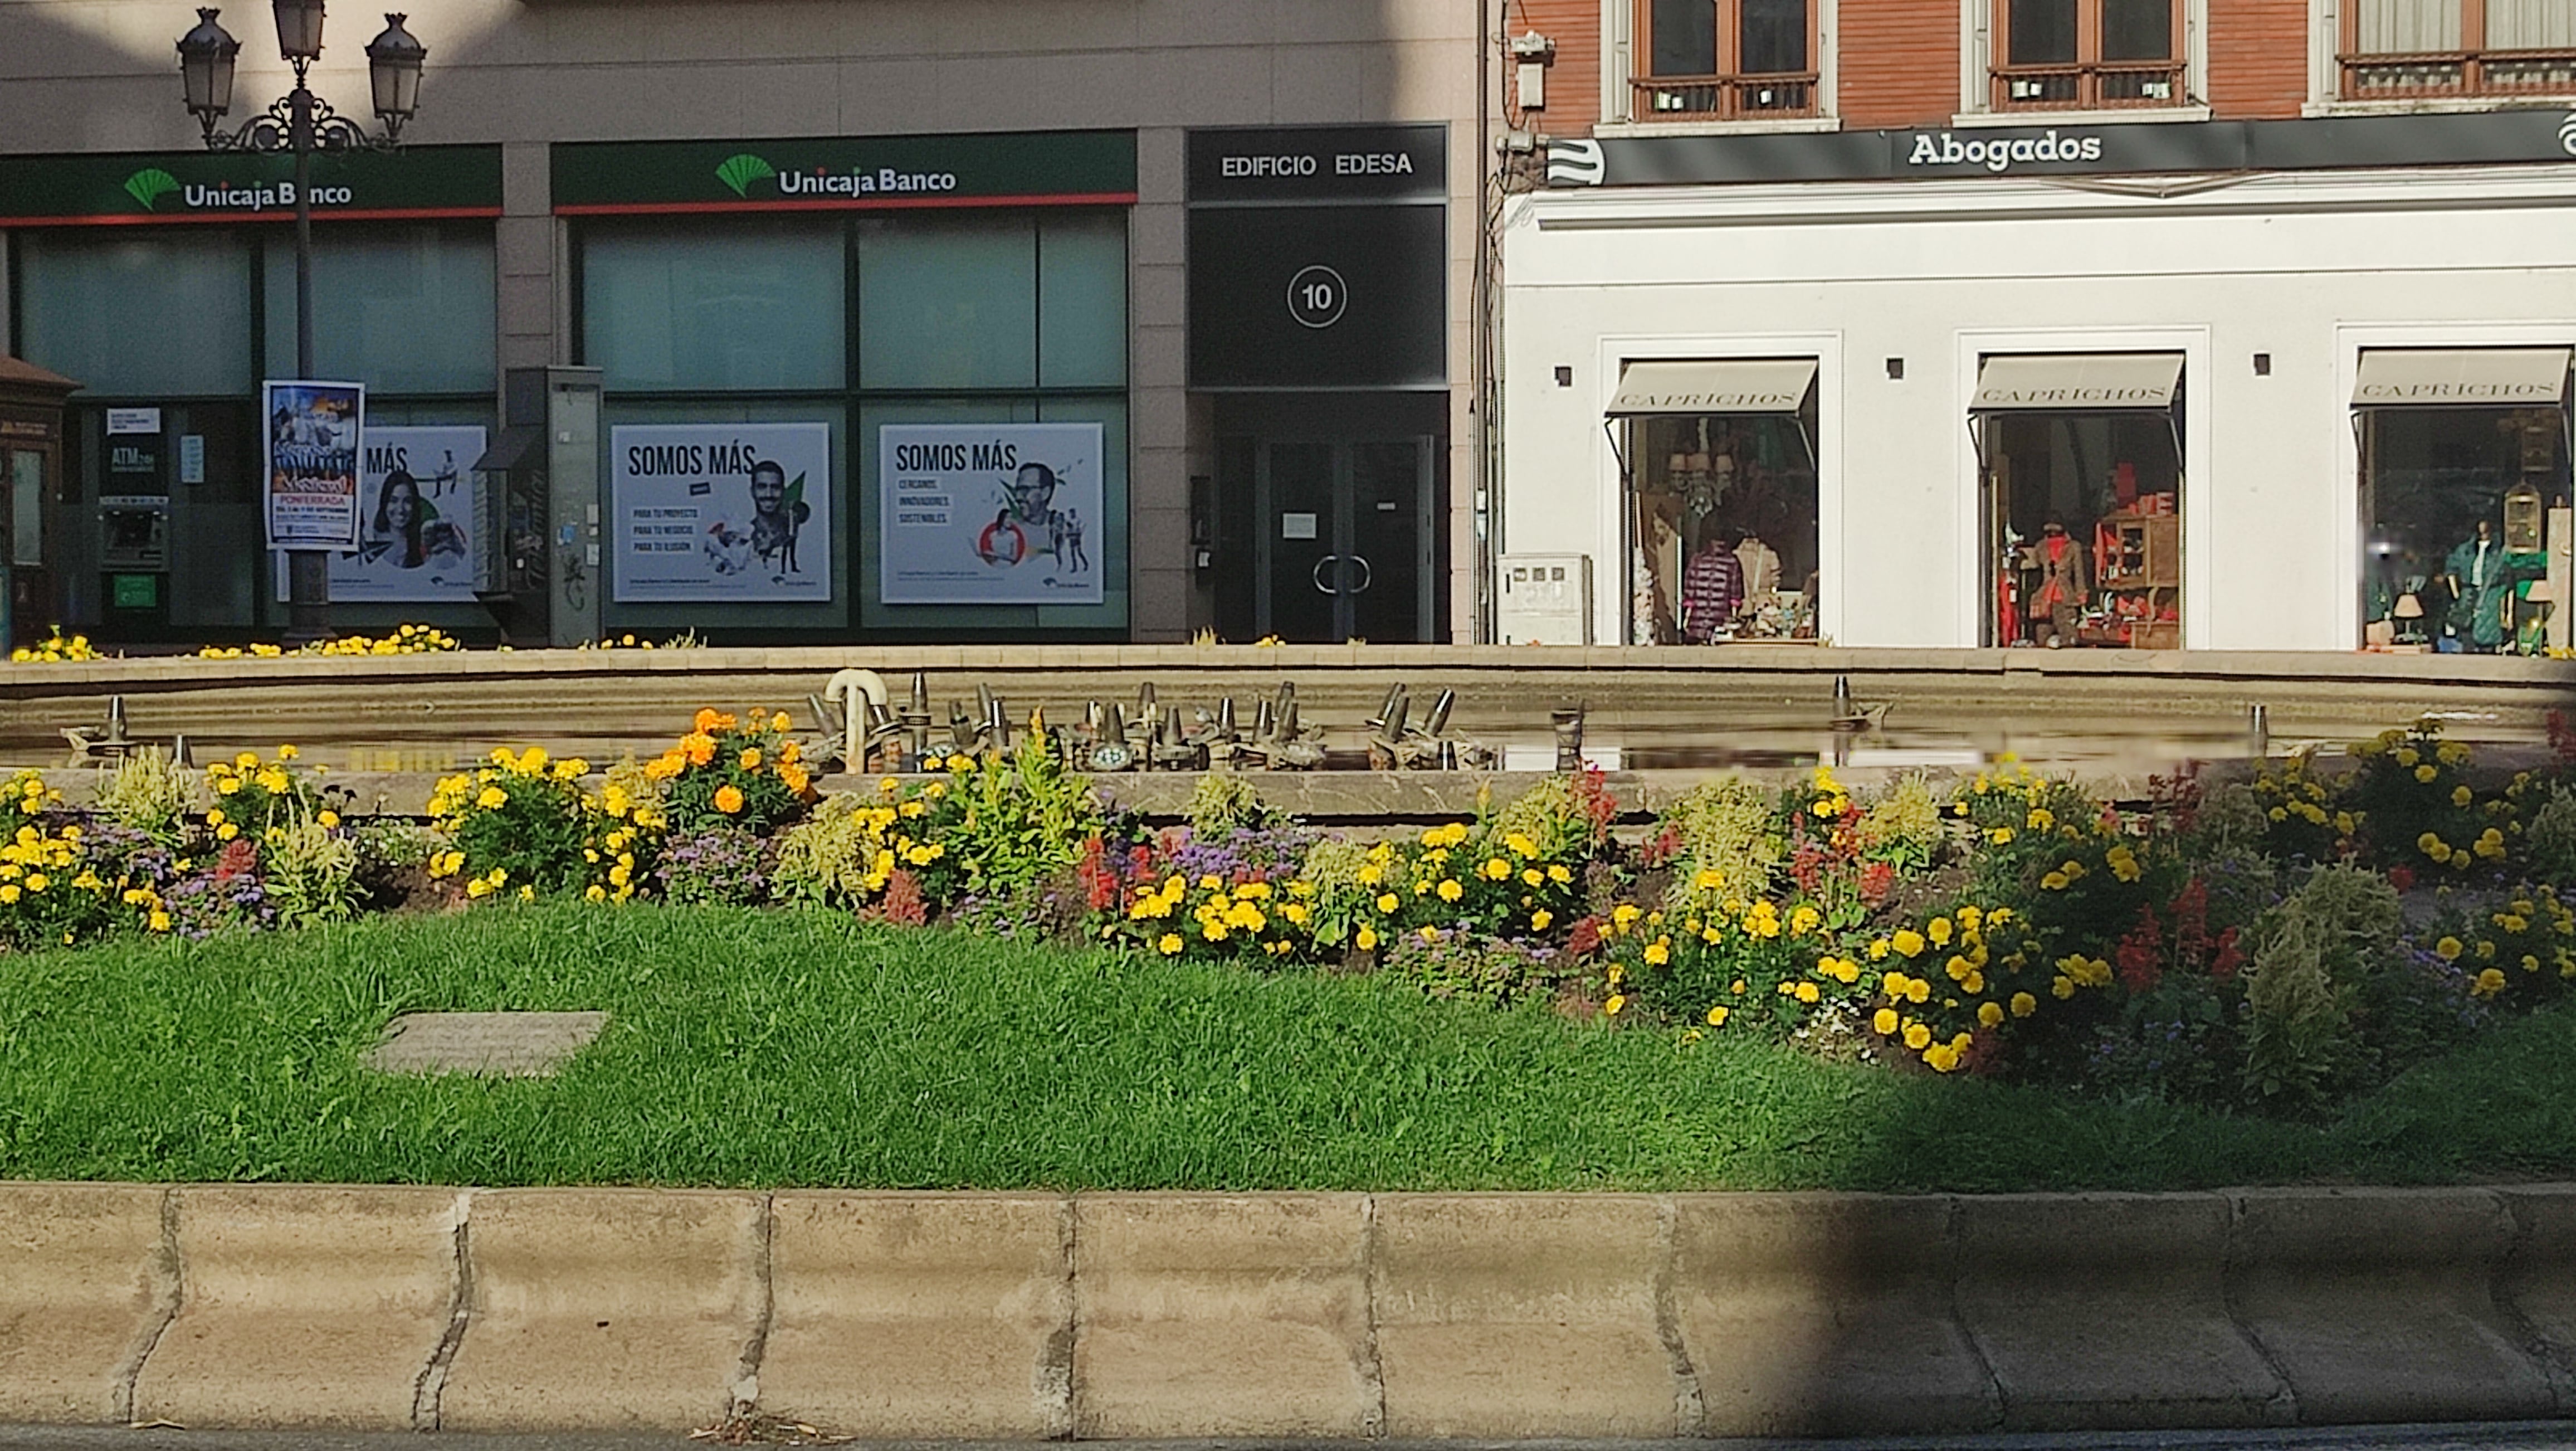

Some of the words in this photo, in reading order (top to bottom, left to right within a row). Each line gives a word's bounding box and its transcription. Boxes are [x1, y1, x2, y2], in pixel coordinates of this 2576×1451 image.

[1909, 131, 2101, 172] Abogados
[1222, 156, 1316, 177] EDIFICIO
[1335, 153, 1413, 174] EDESA
[779, 167, 875, 198] Unicaja
[879, 169, 956, 191] Banco
[184, 181, 277, 211] Unicaja
[279, 182, 352, 206] Bnco
[1301, 284, 1332, 310] 10
[1620, 392, 1797, 407] CAPRICHOS
[1982, 386, 2166, 402] CAPRICHOS
[2362, 381, 2555, 397] CAPRICHOS
[112, 447, 138, 465] ATM
[365, 441, 408, 474] MÁS
[629, 445, 702, 476] SOMOS
[709, 439, 757, 475] MÁS
[896, 444, 967, 471] SOMOS
[972, 439, 1017, 471] MÁS
[280, 495, 345, 505] PONFERRADA
